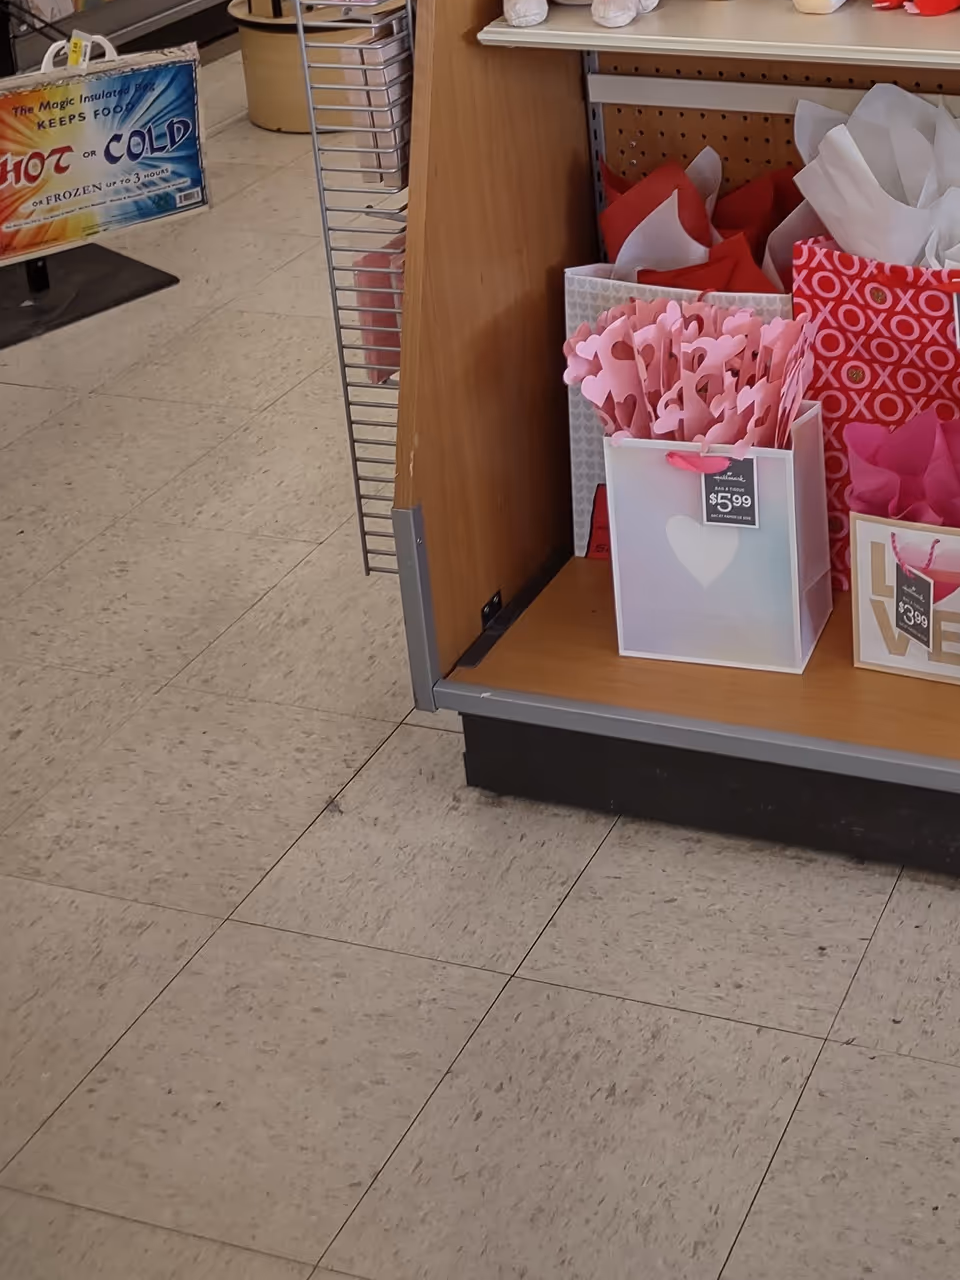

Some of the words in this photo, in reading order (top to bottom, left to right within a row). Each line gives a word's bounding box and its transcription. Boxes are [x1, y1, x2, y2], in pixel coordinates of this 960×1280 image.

[12, 104, 34, 118] The
[38, 96, 75, 113] Magic
[79, 86, 129, 104] Insulated
[37, 112, 87, 131] KEEPS
[93, 103, 135, 121] FOOD
[82, 150, 97, 159] OR
[103, 117, 192, 165] COLD
[45, 183, 103, 206] FROZEN
[106, 180, 117, 188] UP
[133, 172, 141, 184] 3
[143, 167, 170, 179] HOURS
